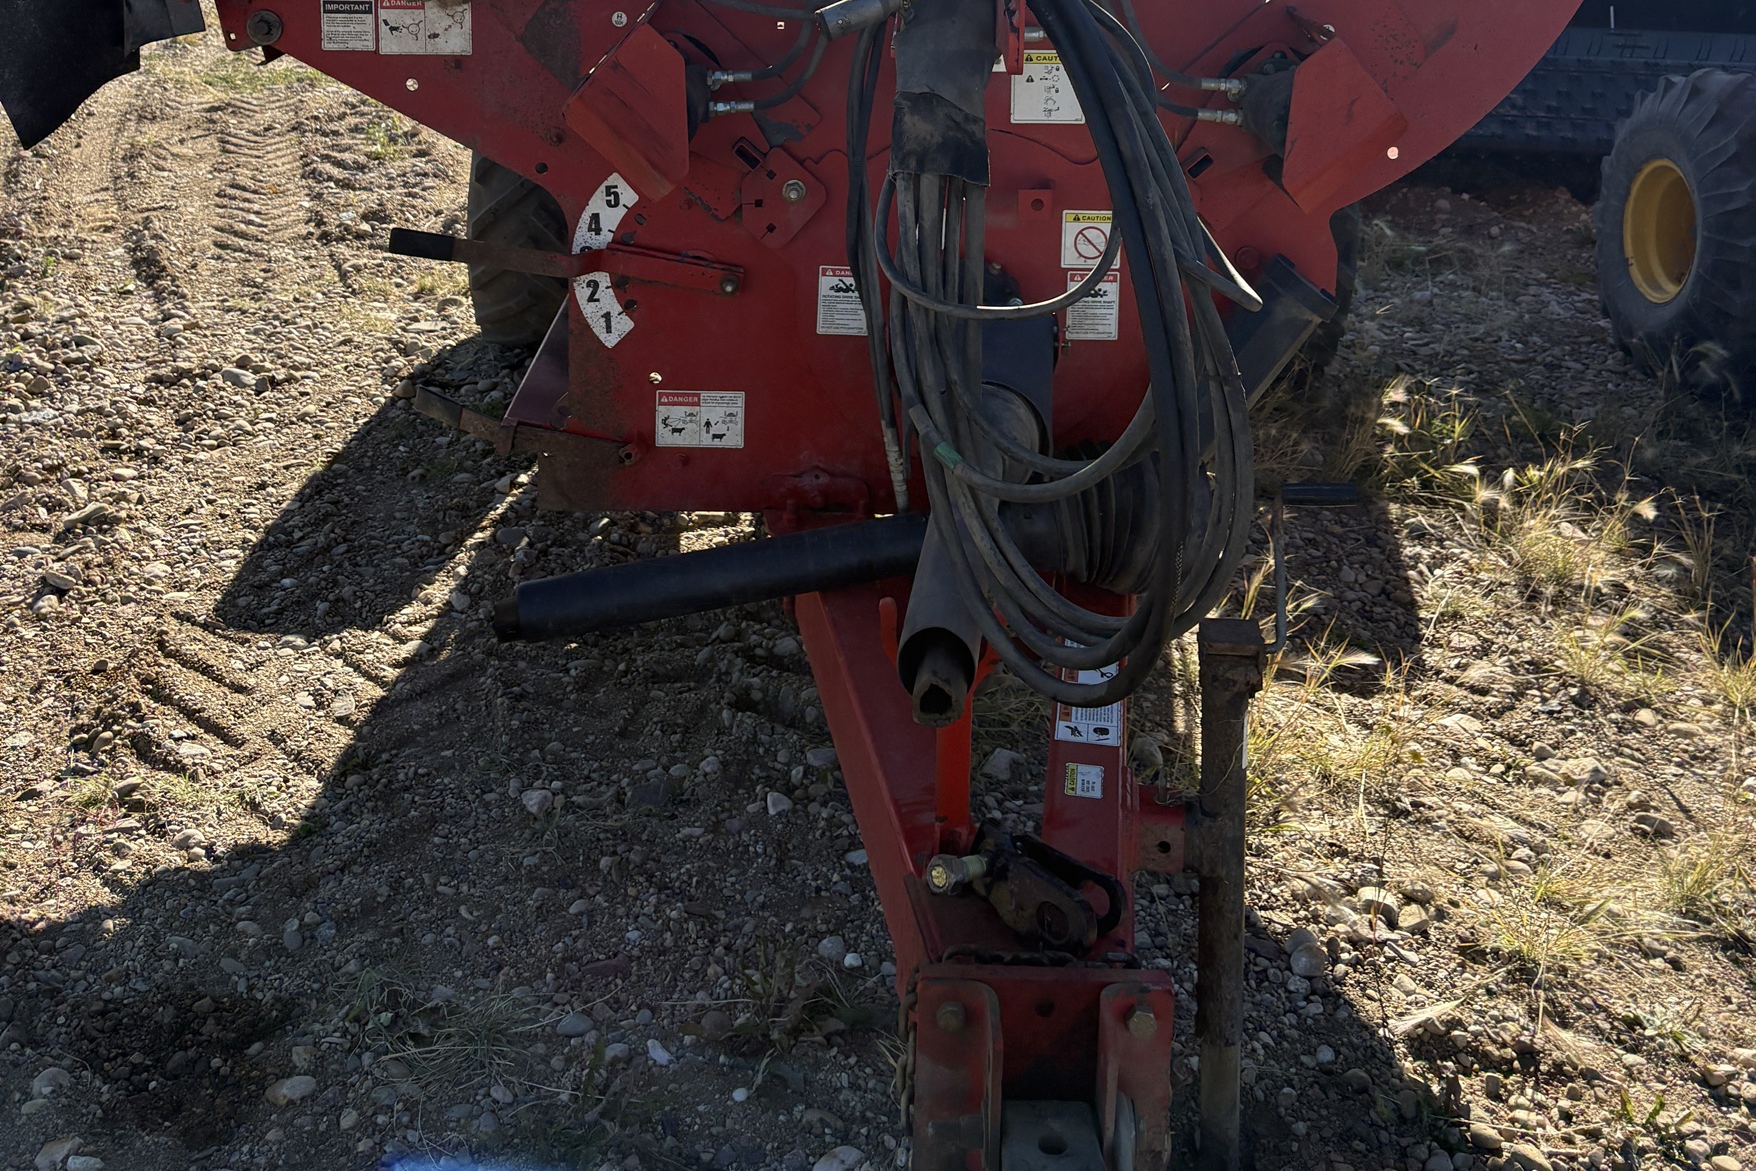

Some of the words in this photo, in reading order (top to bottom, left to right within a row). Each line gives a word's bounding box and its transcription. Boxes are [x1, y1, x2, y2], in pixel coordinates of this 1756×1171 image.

[325, 3, 370, 11] IMPORTANT
[391, 0, 422, 7] DANGER
[605, 184, 620, 209] 5
[587, 212, 602, 236] 4
[585, 279, 600, 303] 2
[601, 310, 613, 334] 1
